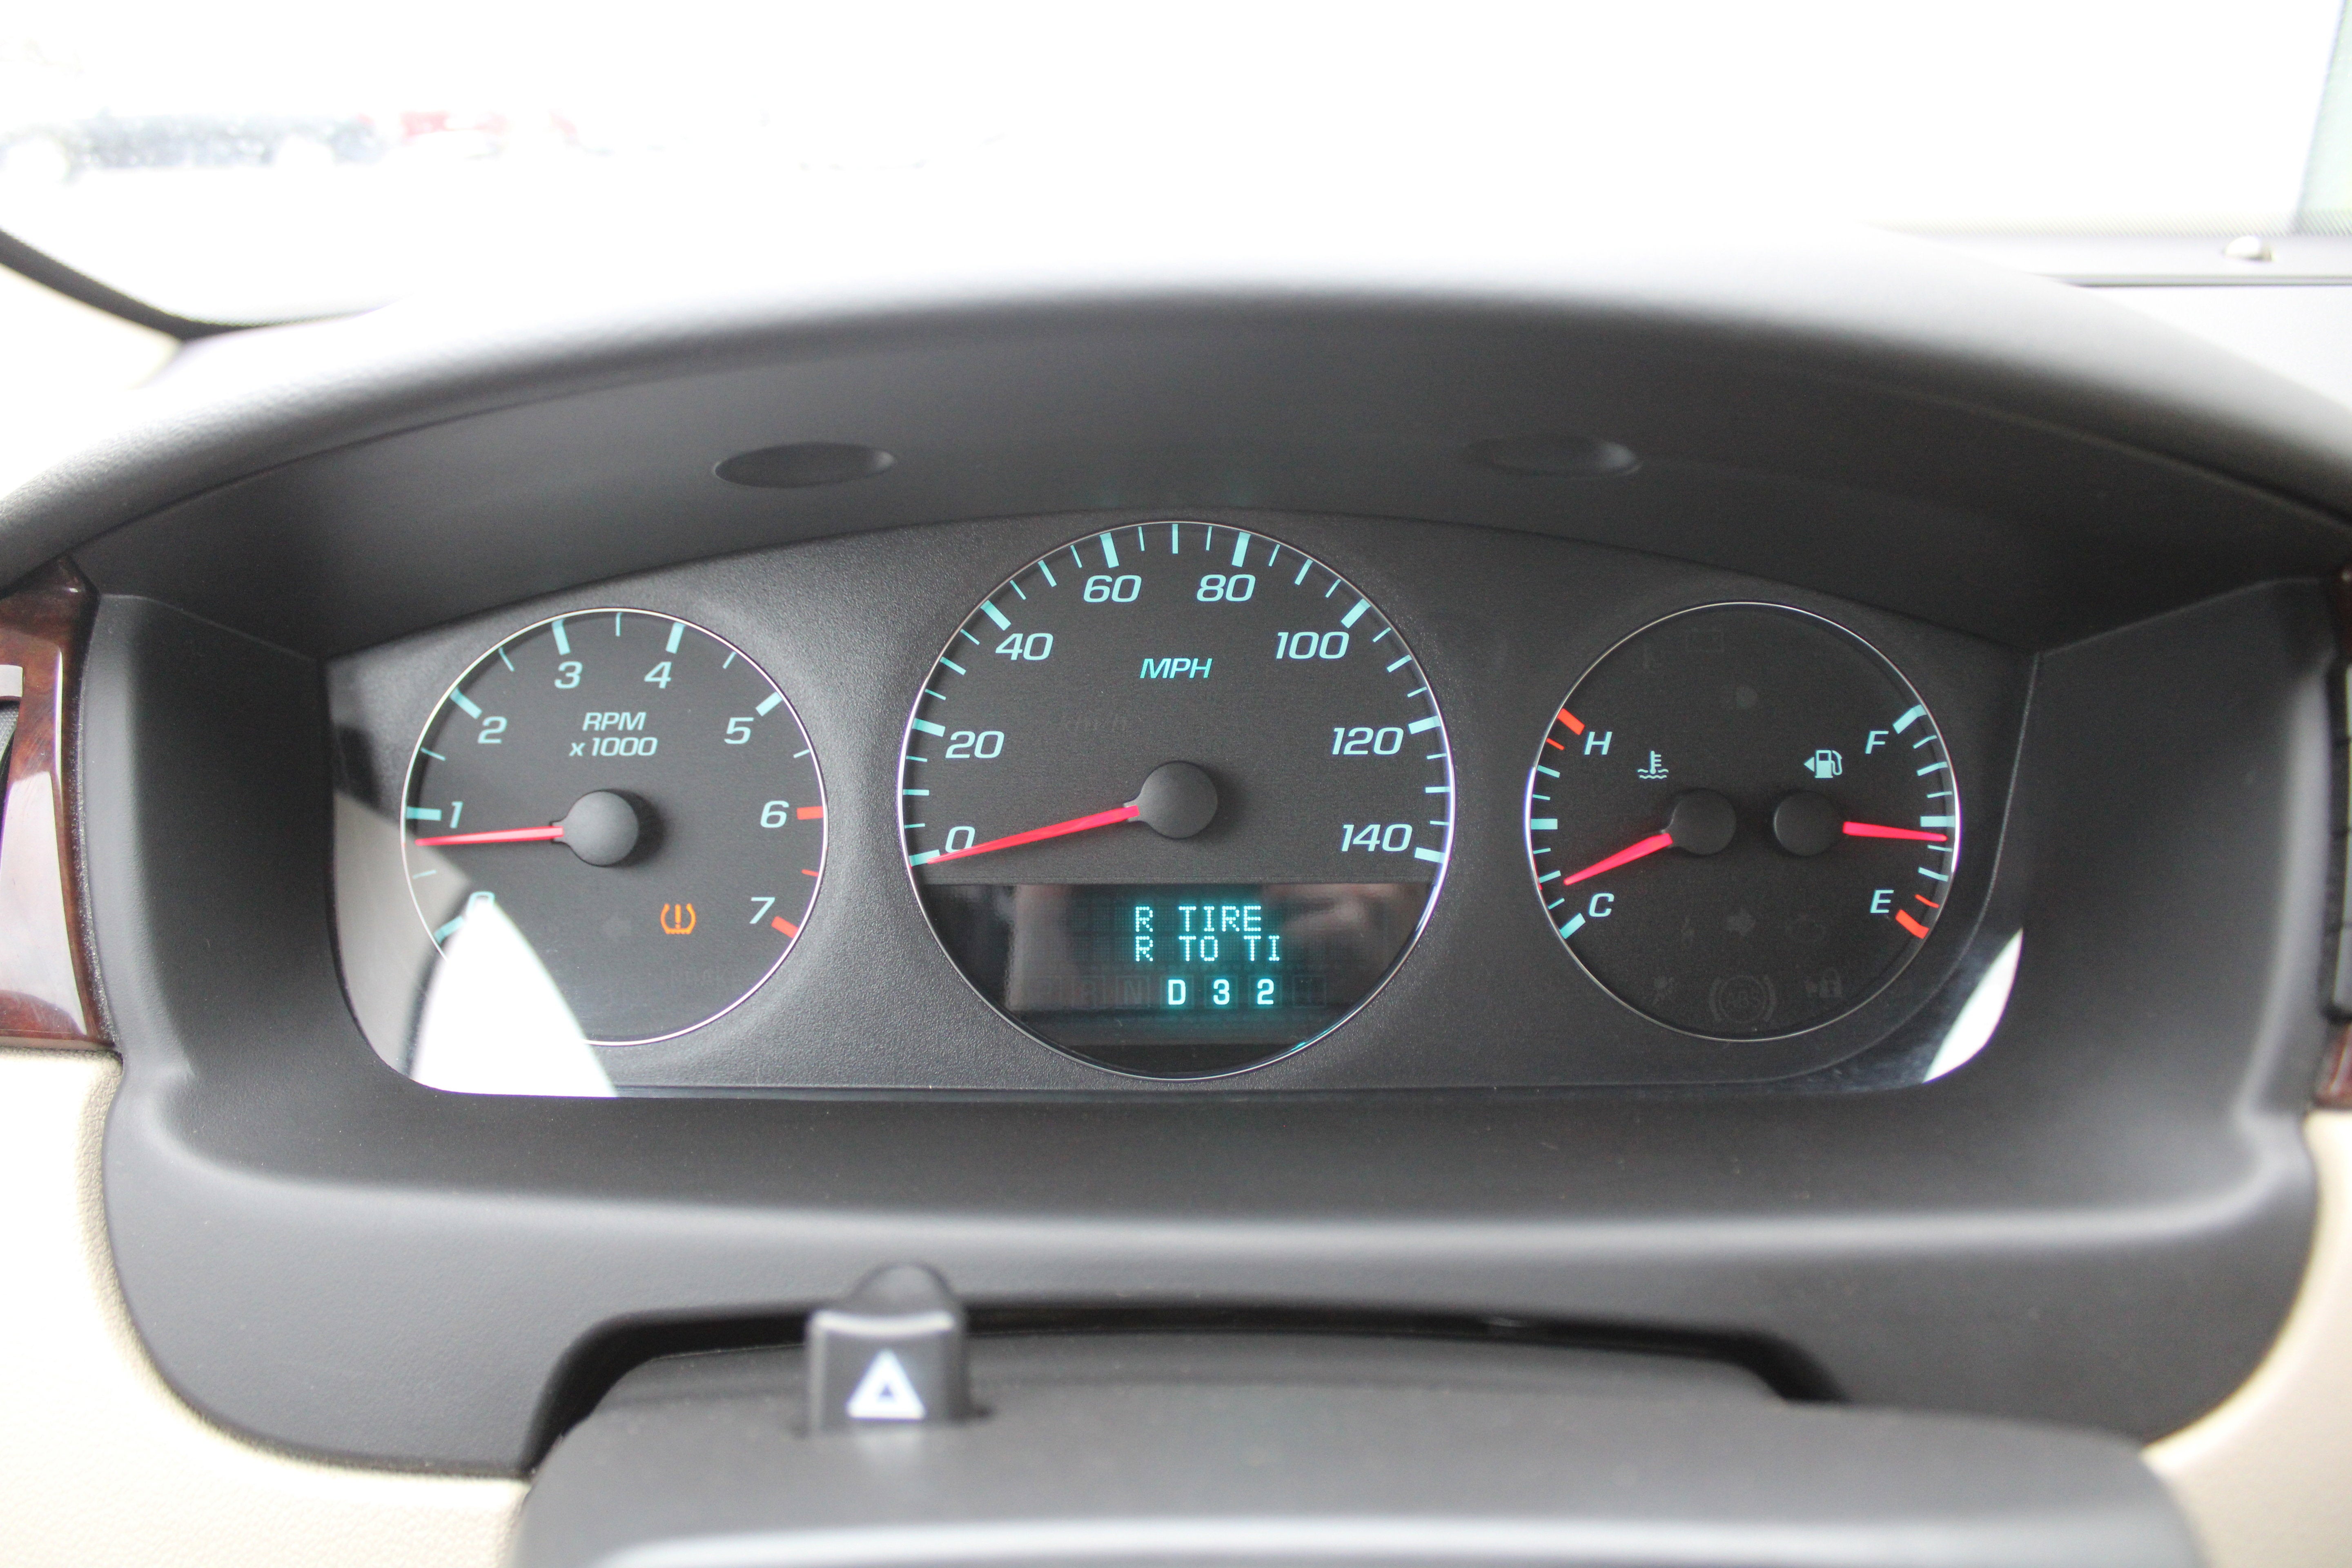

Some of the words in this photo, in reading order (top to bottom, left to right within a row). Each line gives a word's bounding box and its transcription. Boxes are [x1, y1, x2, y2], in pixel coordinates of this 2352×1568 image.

[1083, 575, 1143, 603] 60
[1196, 574, 1256, 602] 80
[995, 633, 1054, 661] 40
[1275, 631, 1350, 659] 100
[555, 661, 584, 689] 3
[645, 662, 673, 689] 4
[1139, 657, 1213, 679] MPH
[477, 716, 508, 744] 2
[583, 712, 647, 731] RPM
[725, 717, 755, 744] 5
[945, 730, 1005, 759] 20
[1331, 727, 1404, 755] 120
[1583, 731, 1612, 755] H
[1864, 731, 1888, 754] F
[451, 801, 464, 829] 1
[760, 800, 791, 828] 6
[945, 826, 976, 853] 0
[1341, 823, 1413, 852] 140
[750, 897, 775, 924] 7
[1588, 893, 1614, 917] C
[1869, 889, 1893, 913] E
[1135, 906, 1153, 932] R
[1178, 905, 1261, 932] TIRE
[1135, 935, 1154, 962] R
[1178, 935, 1218, 962] TO
[1243, 935, 1280, 961] TI
[1167, 979, 1186, 1005] D
[1213, 978, 1230, 1005] 3
[1257, 978, 1274, 1005] 2
